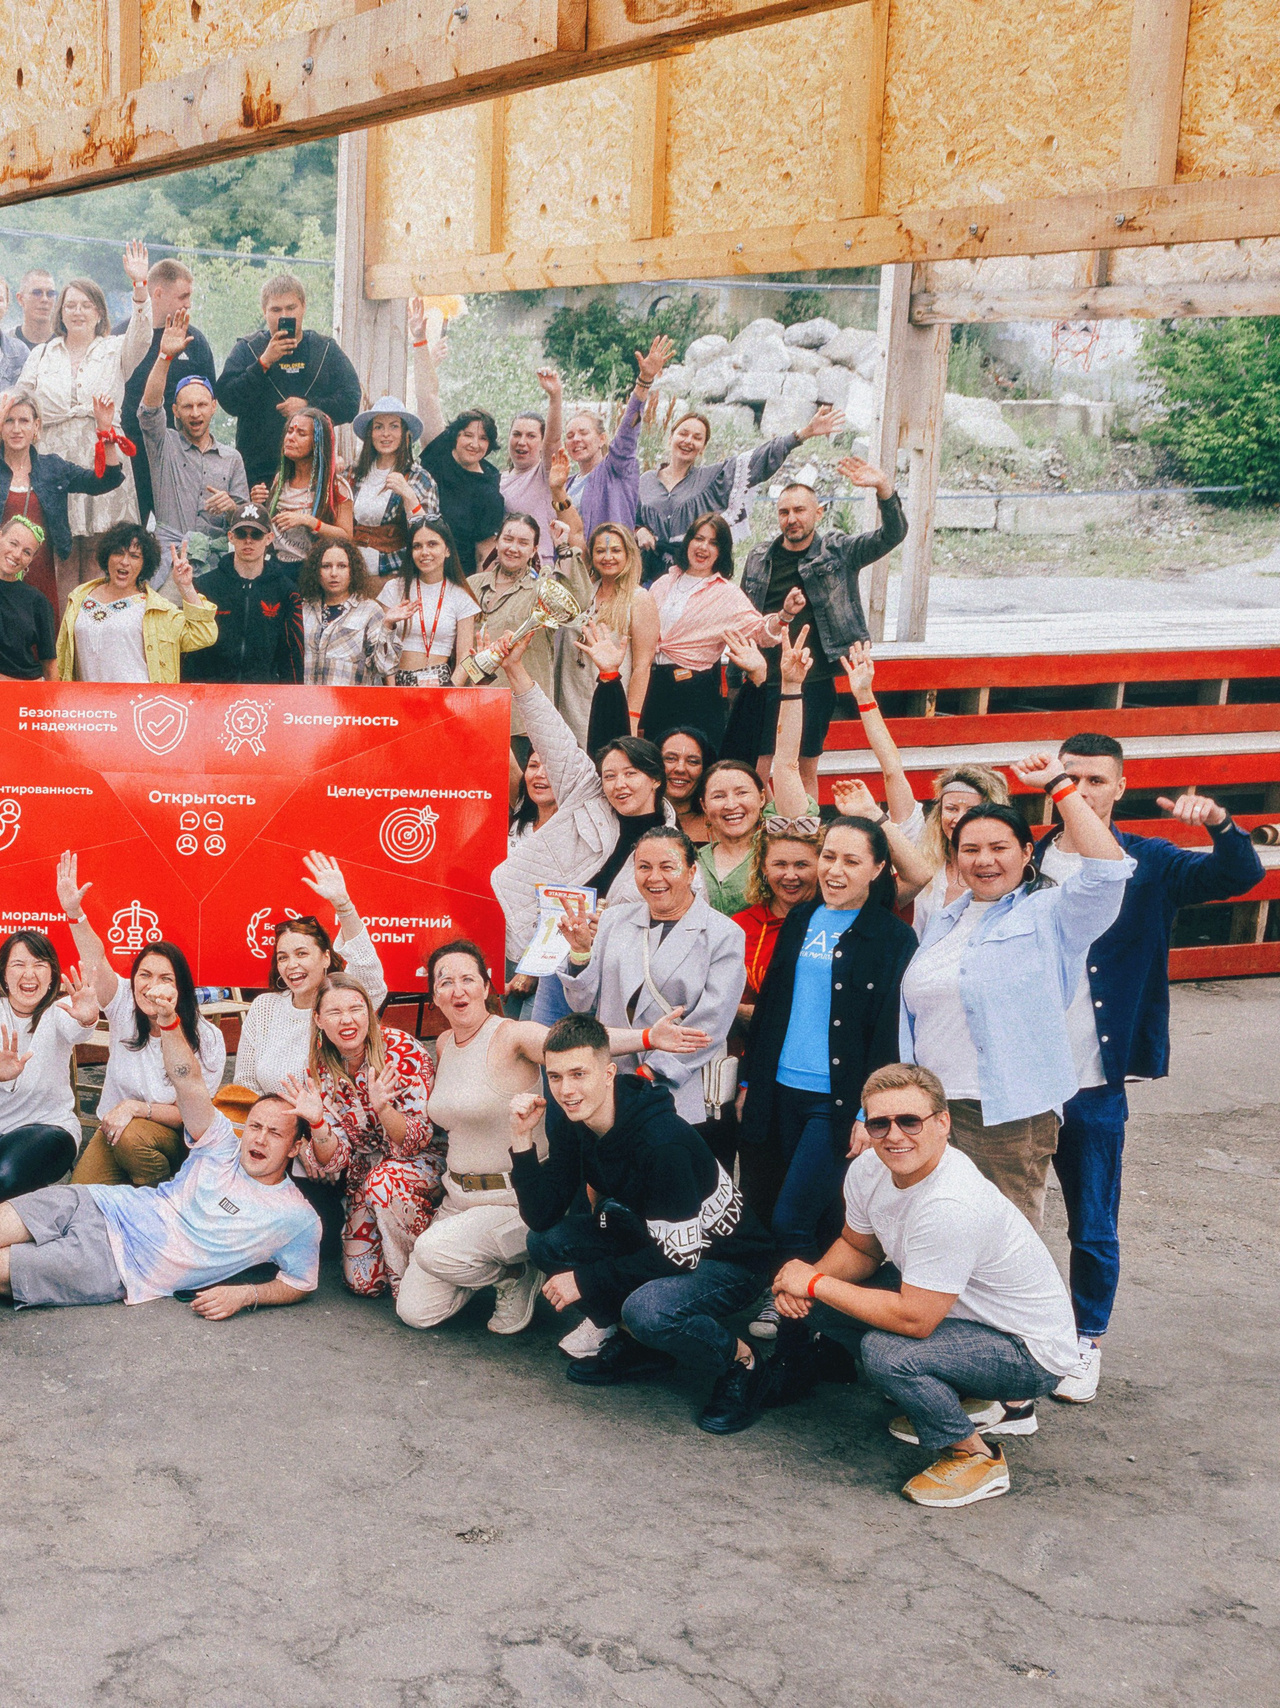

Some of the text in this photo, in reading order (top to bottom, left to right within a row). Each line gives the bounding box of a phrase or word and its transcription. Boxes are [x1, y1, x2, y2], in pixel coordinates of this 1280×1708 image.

[18, 706, 118, 720] Безопасность
[282, 712, 400, 728] Экспертность
[18, 720, 118, 733] и надежность
[148, 789, 256, 806] Открытость
[326, 784, 493, 800] Целеустремленность
[1, 911, 68, 924] моральн
[334, 913, 453, 929] оголетний
[370, 931, 416, 944] опыт
[664, 1224, 700, 1248] KLEI
